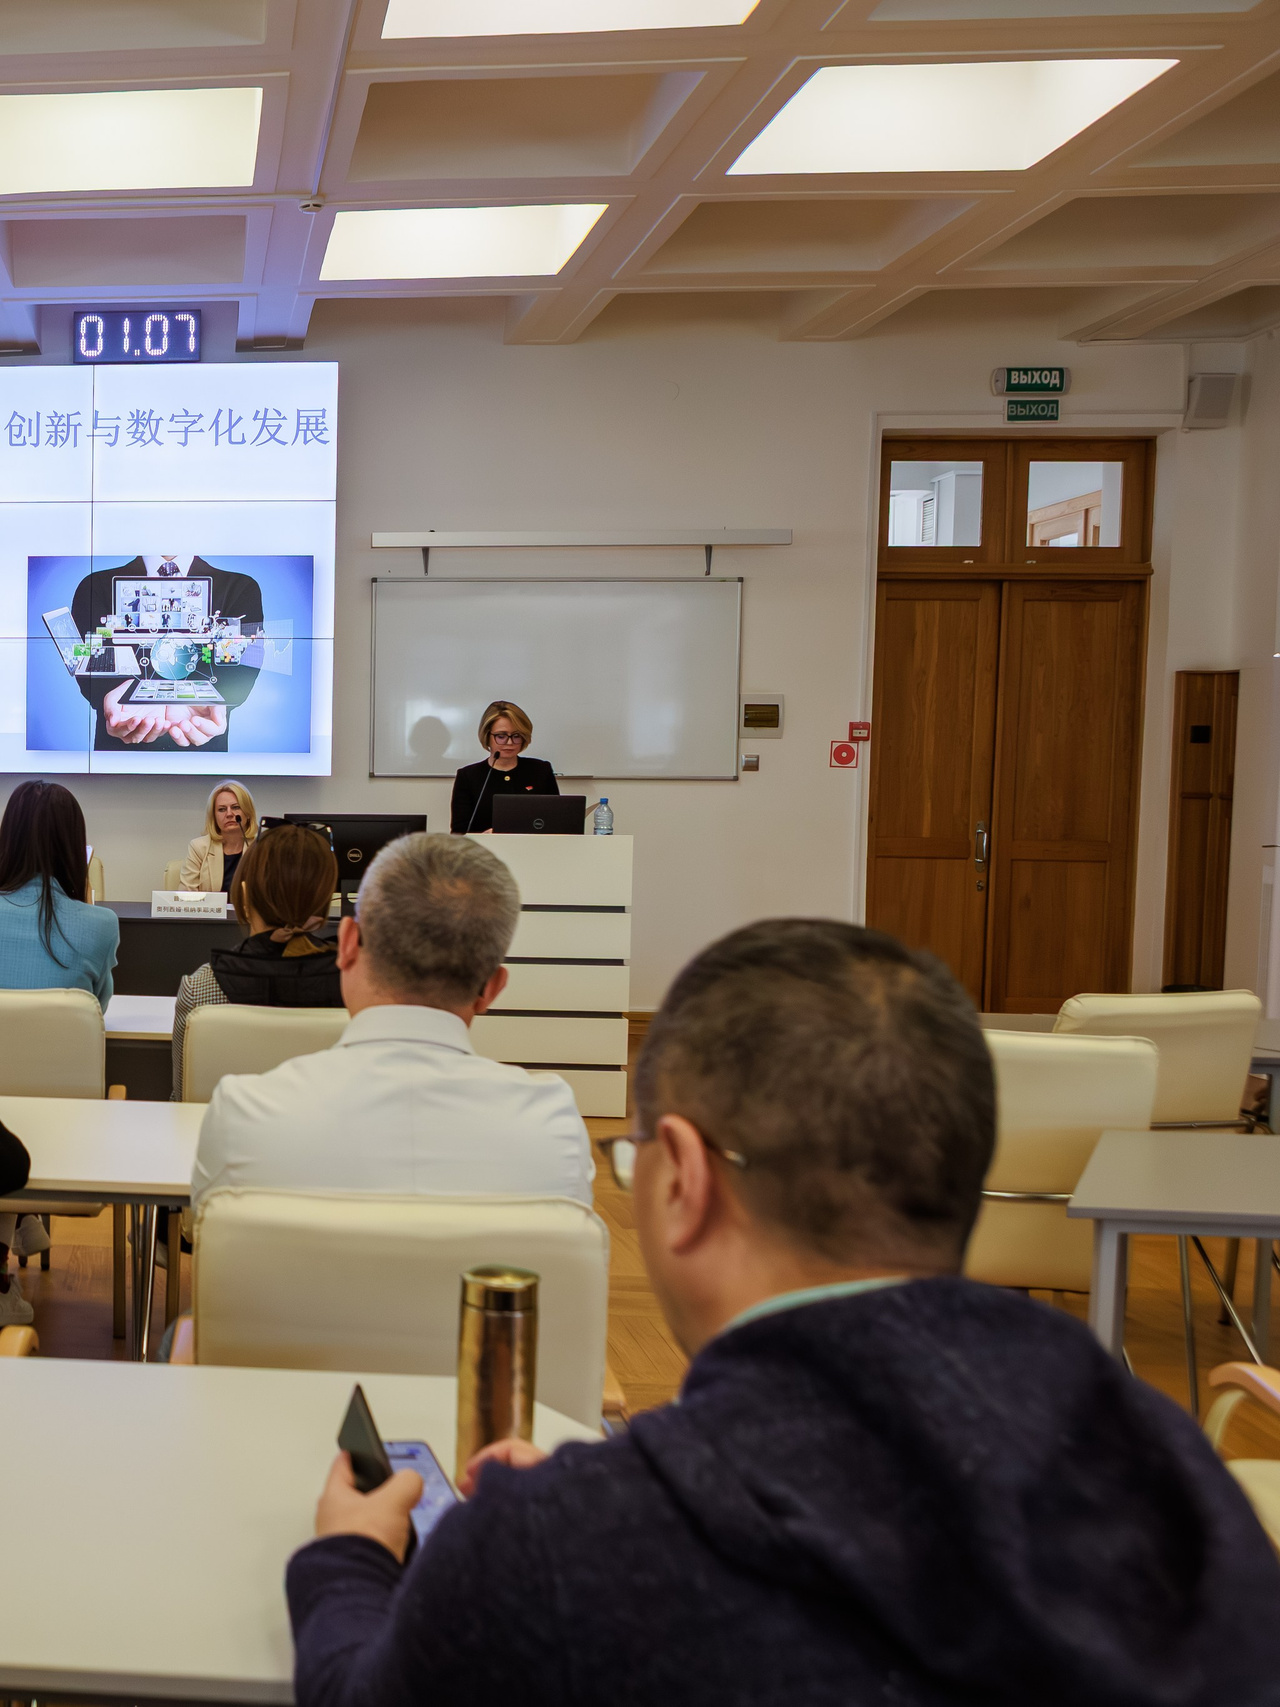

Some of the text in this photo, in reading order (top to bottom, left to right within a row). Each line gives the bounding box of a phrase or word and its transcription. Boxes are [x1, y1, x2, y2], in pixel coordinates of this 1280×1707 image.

[80, 314, 195, 356] 01.07
[1010, 370, 1060, 388] ВЫХОД
[1008, 404, 1057, 418] ВЫХОД
[4, 408, 330, 448] 创新与数字化发展
